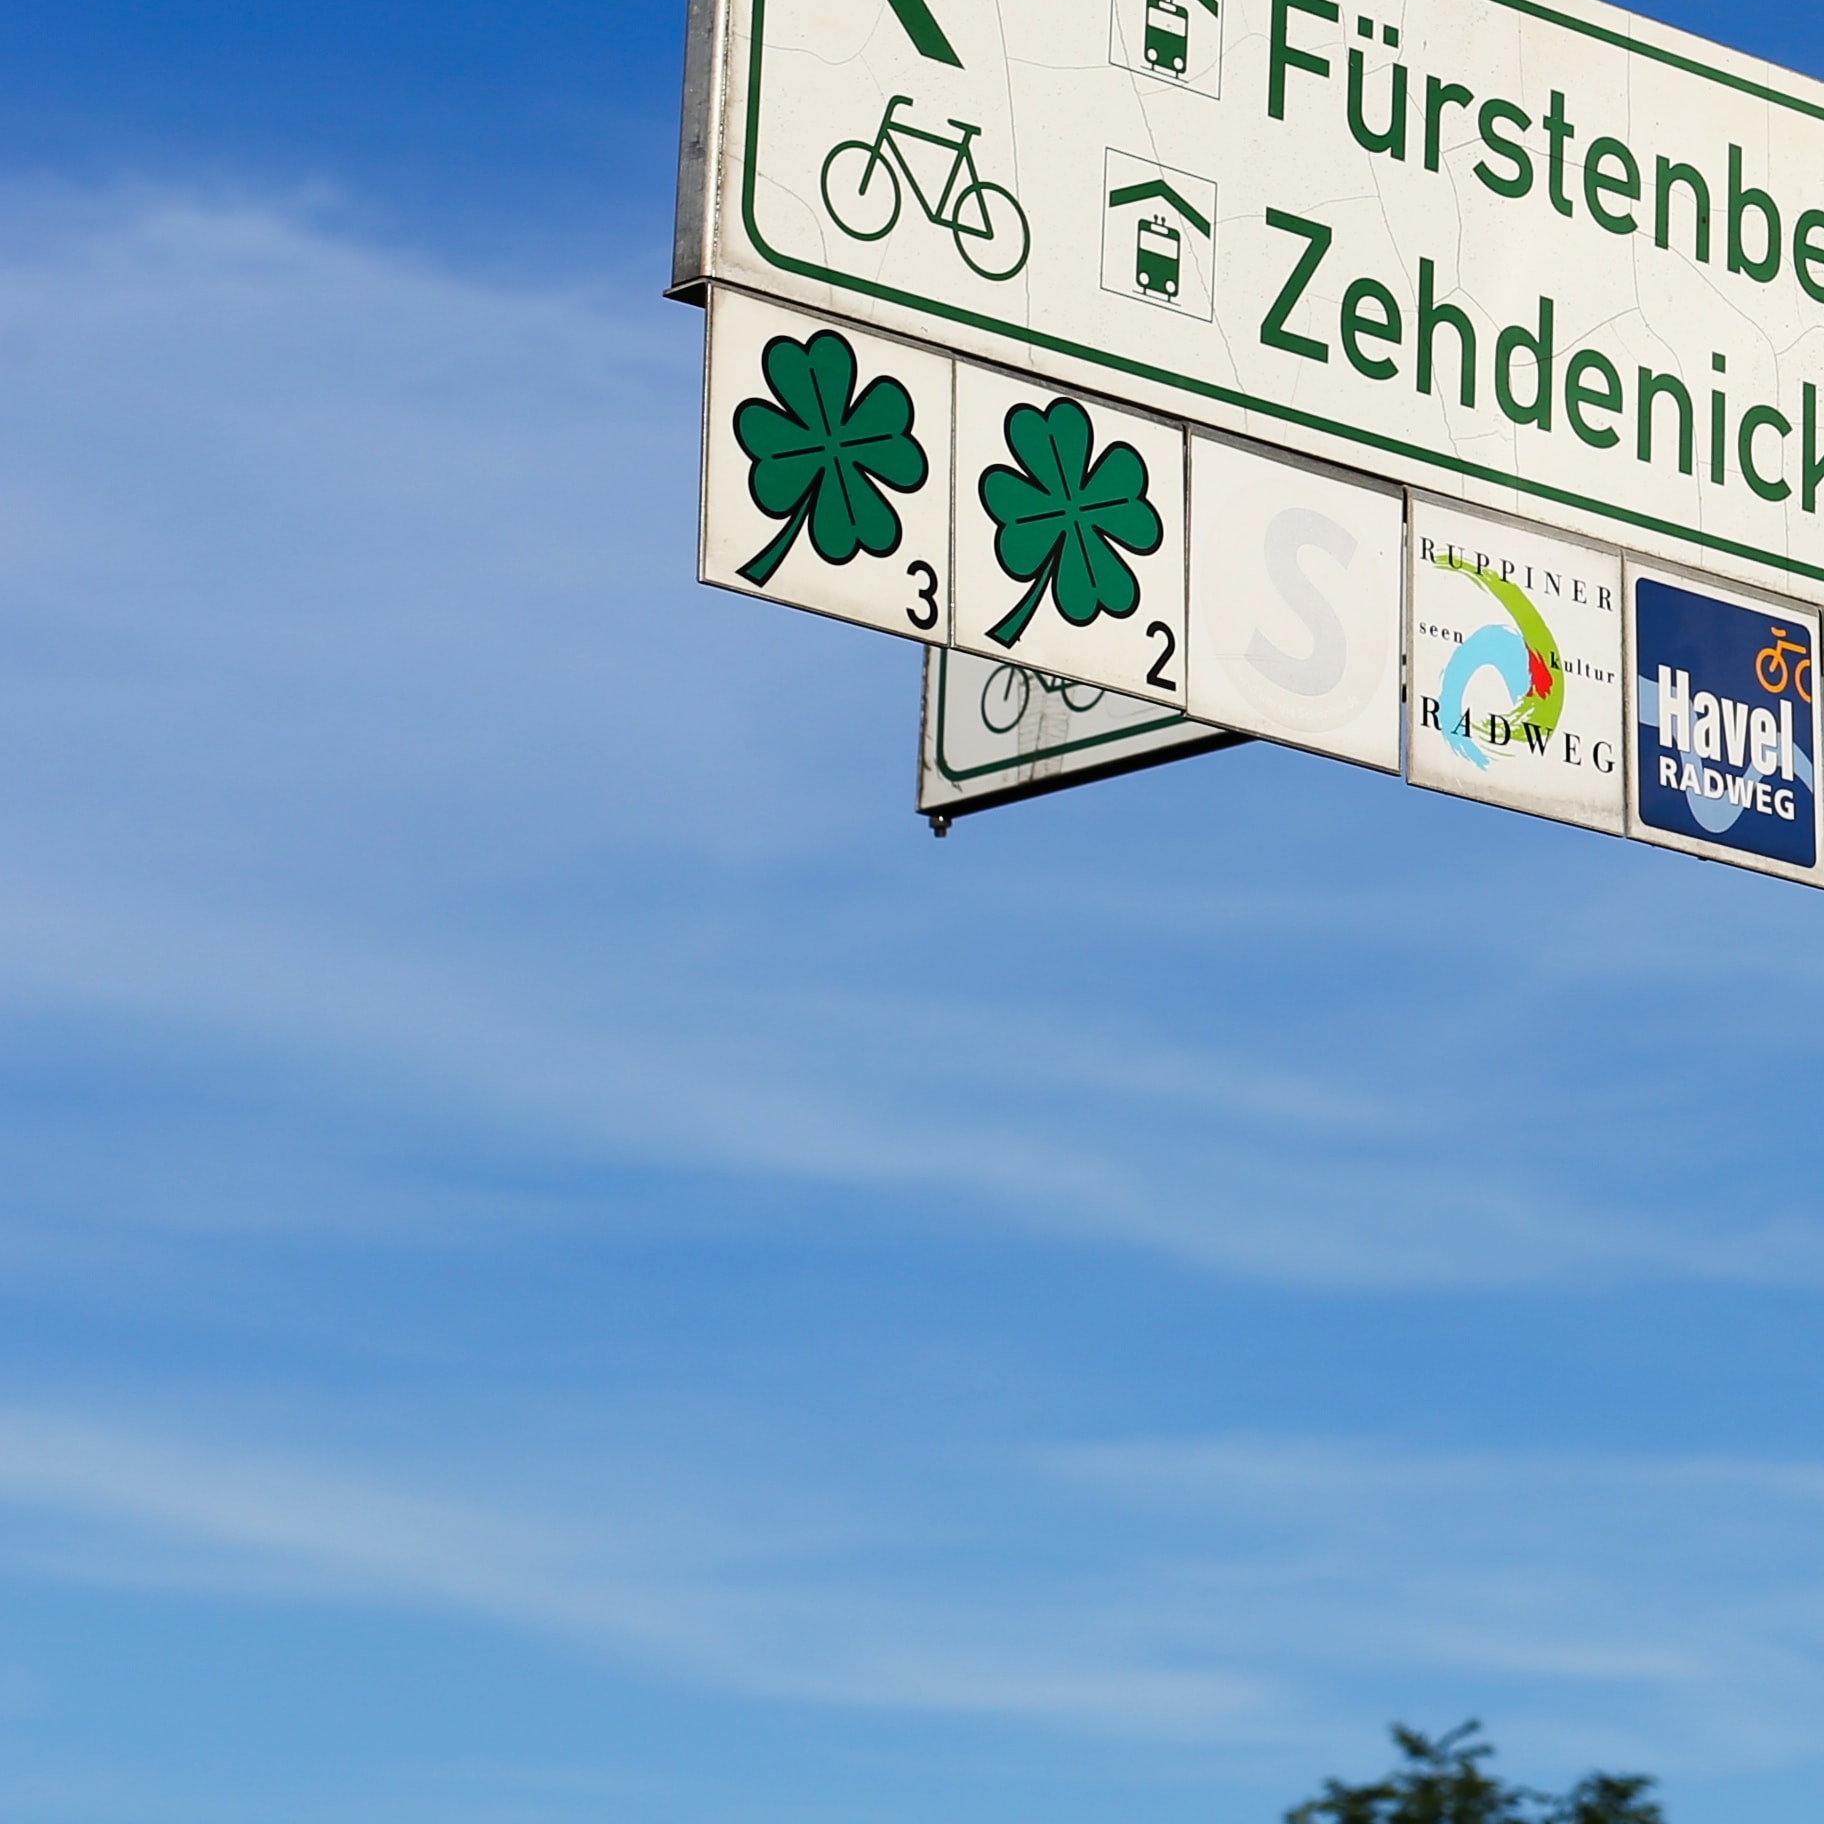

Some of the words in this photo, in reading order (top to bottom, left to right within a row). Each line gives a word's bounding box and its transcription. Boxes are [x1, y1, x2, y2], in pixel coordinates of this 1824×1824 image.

[905, 559, 939, 631] 3
[1244, 507, 1359, 697] S
[1419, 536, 1613, 612] RUPPINER
[1145, 620, 1177, 692] 2
[1418, 621, 1465, 645] seen
[1549, 651, 1616, 684] kultur
[1419, 695, 1616, 774] RADWEG
[1657, 663, 1795, 782] Havel
[1658, 755, 1796, 821] RADWEG
